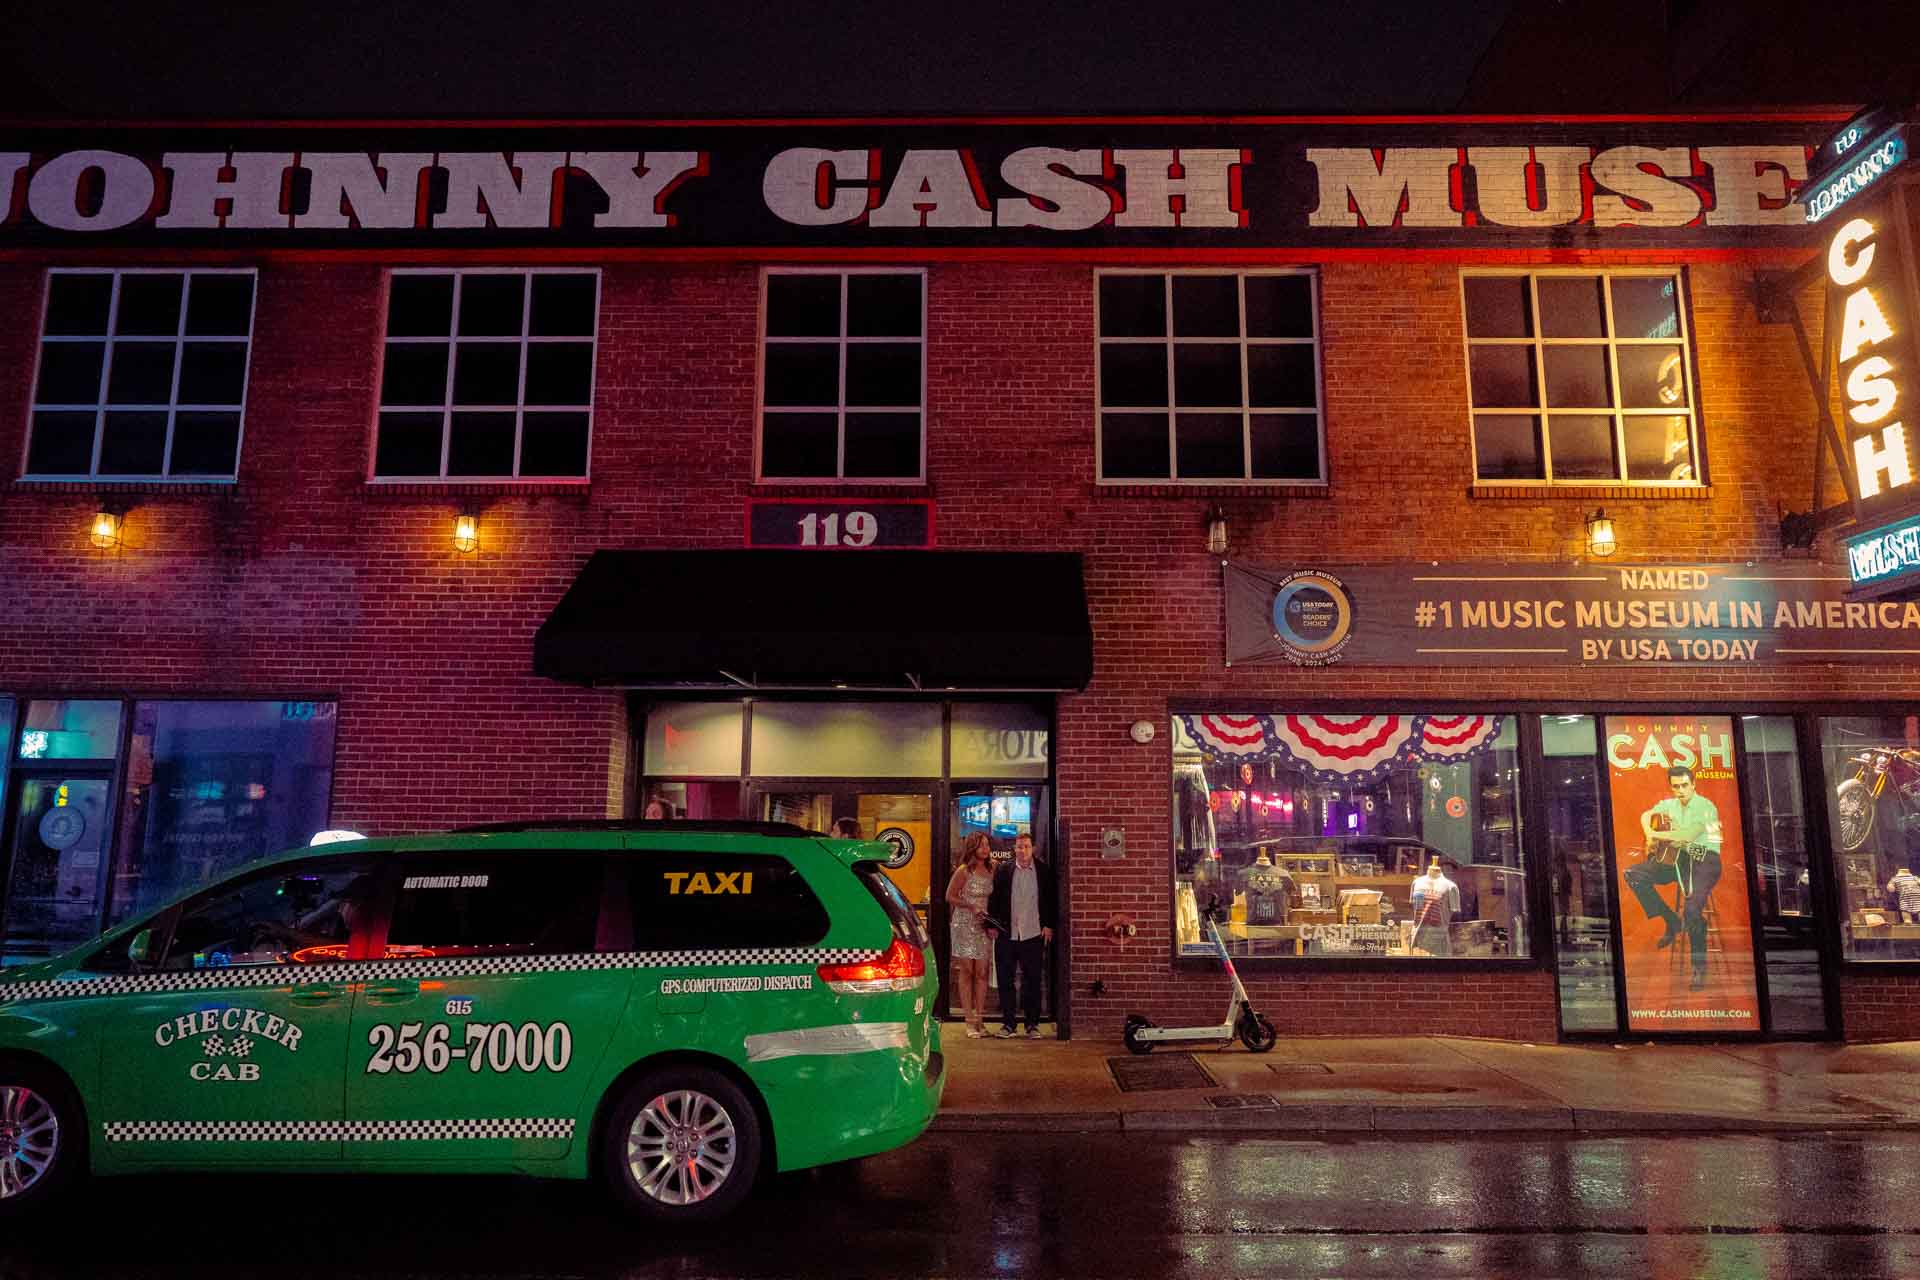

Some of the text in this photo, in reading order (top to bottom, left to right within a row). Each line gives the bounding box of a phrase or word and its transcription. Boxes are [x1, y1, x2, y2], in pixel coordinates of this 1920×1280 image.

[763, 146, 1243, 230] CASH
[1828, 218, 1912, 500] CASH
[798, 511, 878, 546] 119
[1848, 526, 1920, 582] MUSE
[1621, 570, 1709, 590] NAMED
[1415, 601, 1920, 629] #1 MUSIC MUSEUM IN AMERICA
[1583, 640, 1759, 660] BY USA TODAY
[1624, 724, 1708, 732] JOHNNY
[1607, 733, 1734, 770] CASH
[1695, 771, 1734, 779] MUSEUM
[403, 875, 489, 889] AUTOMATIC DOOR
[664, 872, 753, 894] TAXI
[1299, 922, 1352, 940] CASH
[764, 975, 812, 990] DISPATCH
[446, 1001, 472, 1015] 615
[1631, 1010, 1751, 1018] WWW.CASHMUSEUM.COM
[155, 1008, 303, 1051] CHECKER
[367, 1023, 572, 1073] 256-7000
[190, 1063, 260, 1081] CAB
